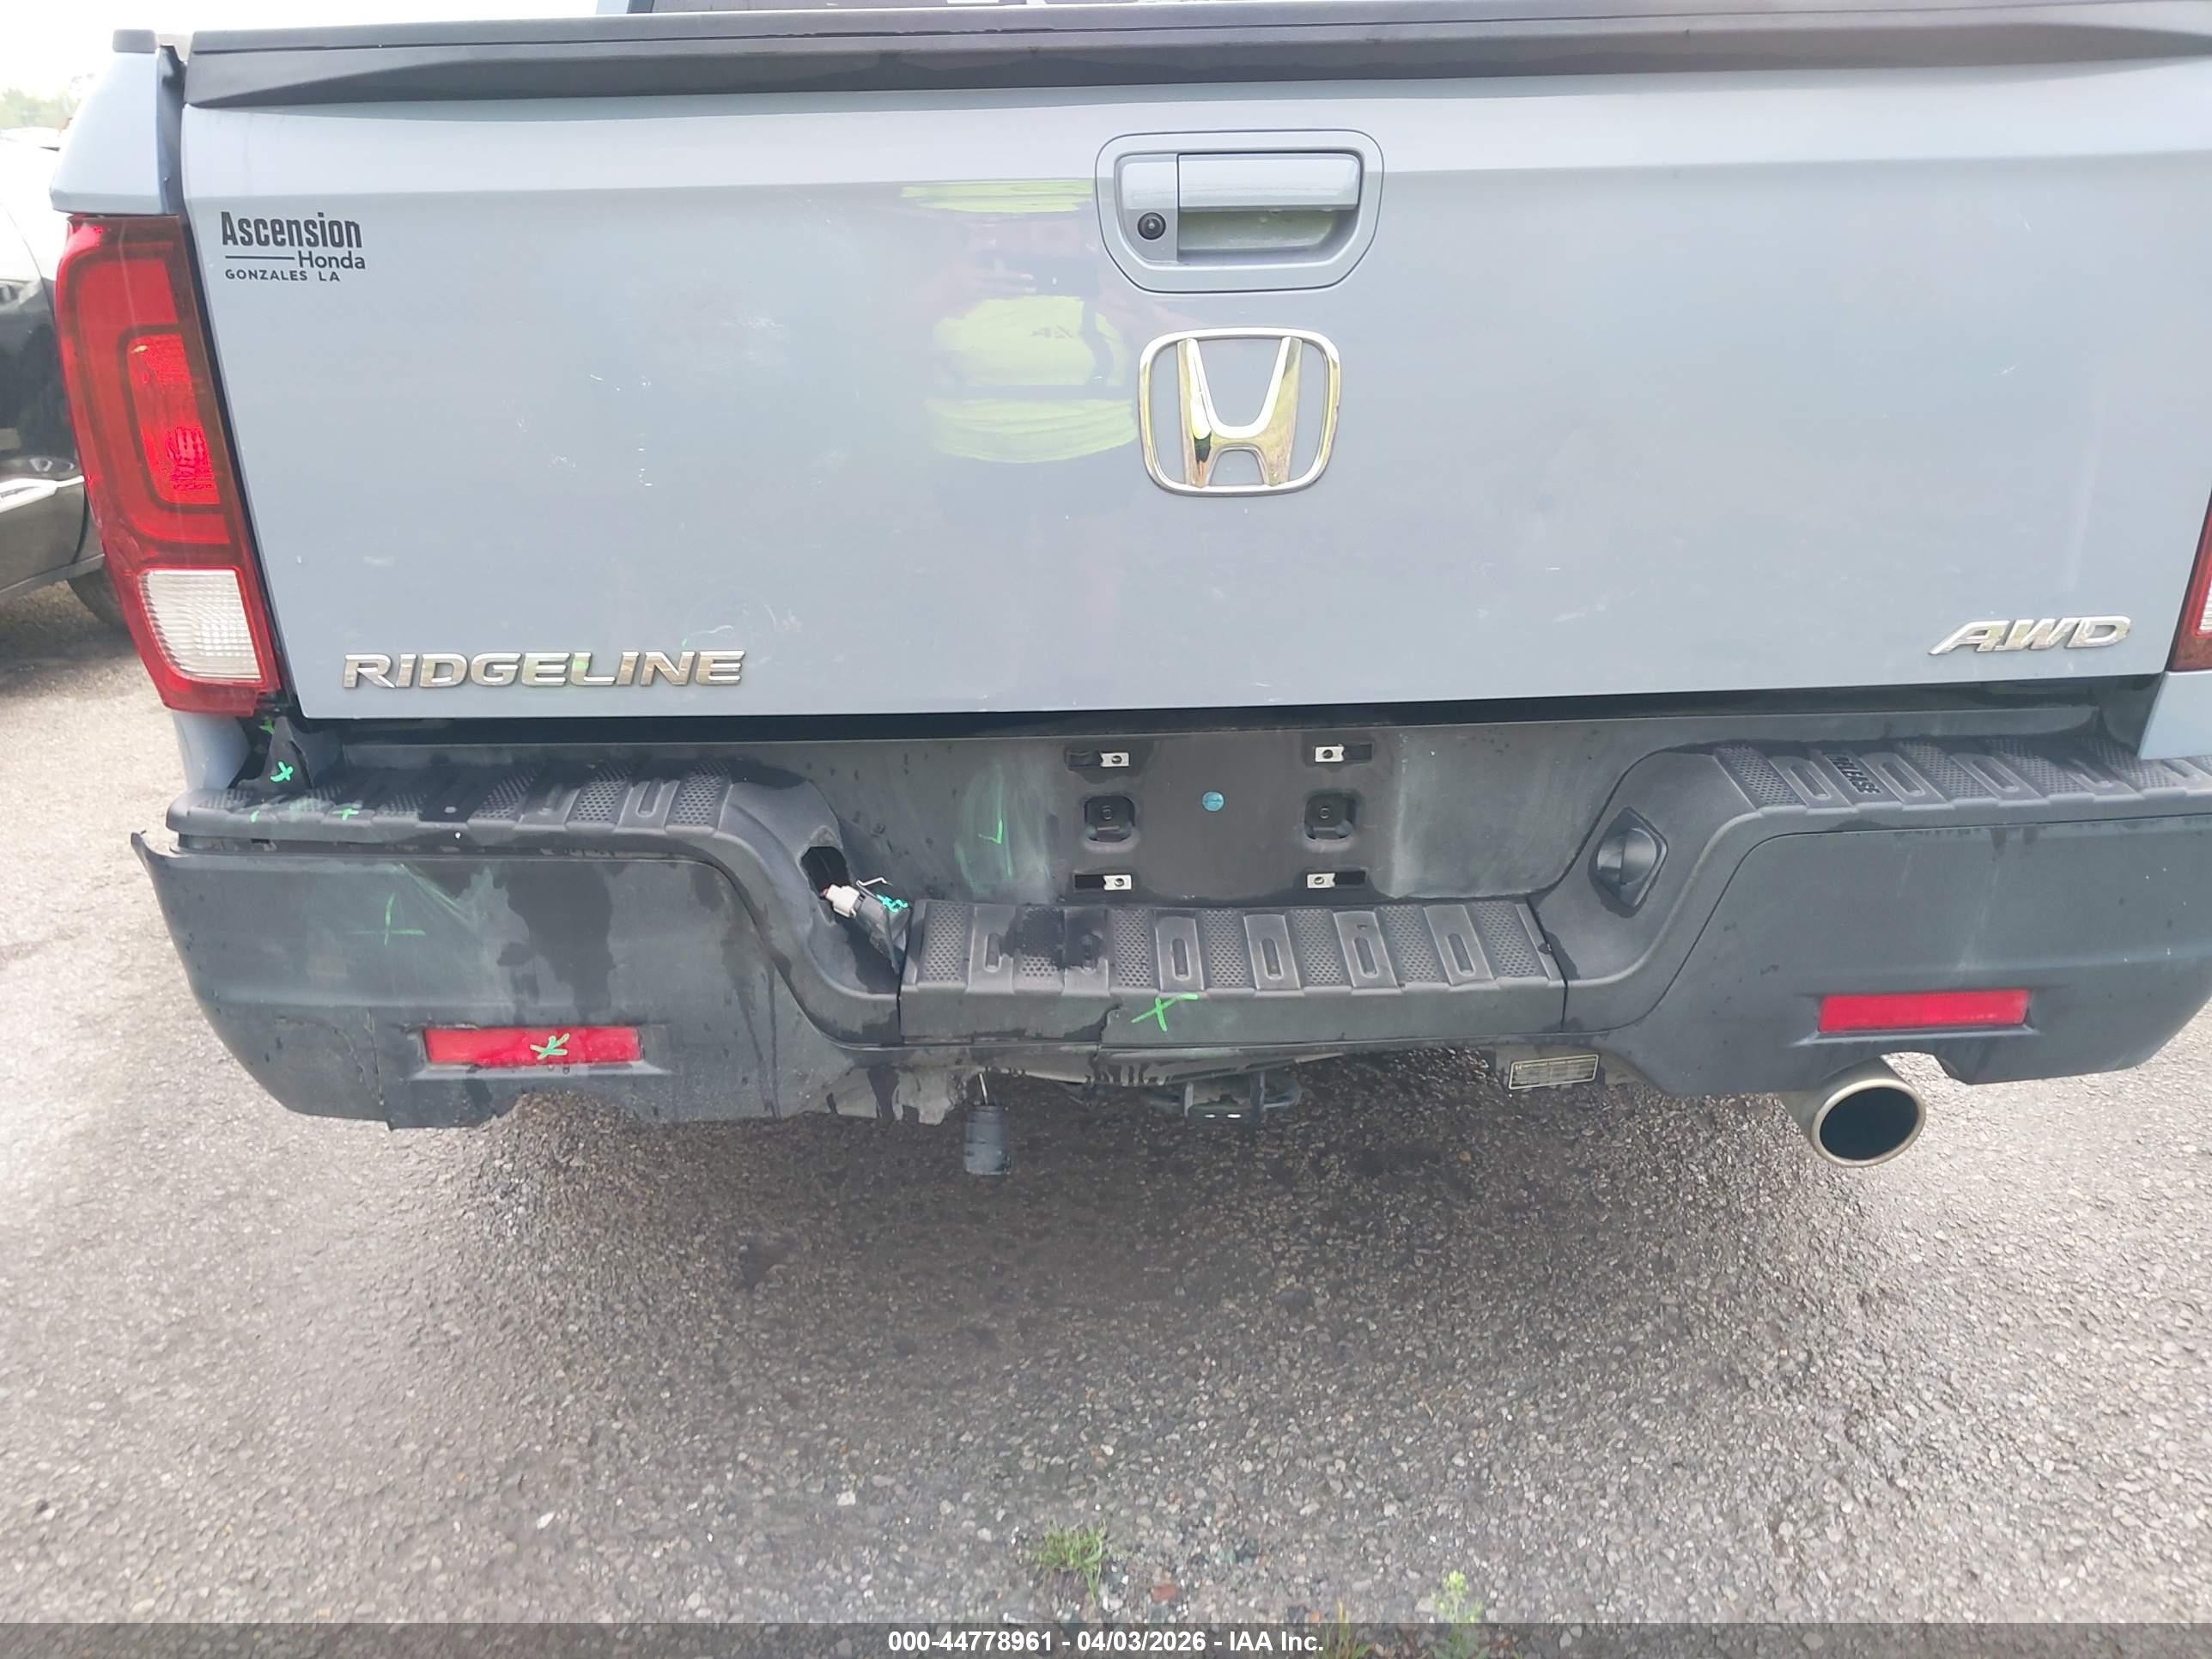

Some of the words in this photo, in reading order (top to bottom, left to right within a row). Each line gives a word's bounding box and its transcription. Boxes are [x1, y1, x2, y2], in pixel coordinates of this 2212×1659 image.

[221, 211, 362, 248] Ascension
[225, 269, 307, 281] GONZALES
[319, 271, 341, 282] LA
[298, 250, 366, 269] Honda
[1928, 615, 2131, 656] AWD
[343, 650, 745, 688] RIDGELINE
